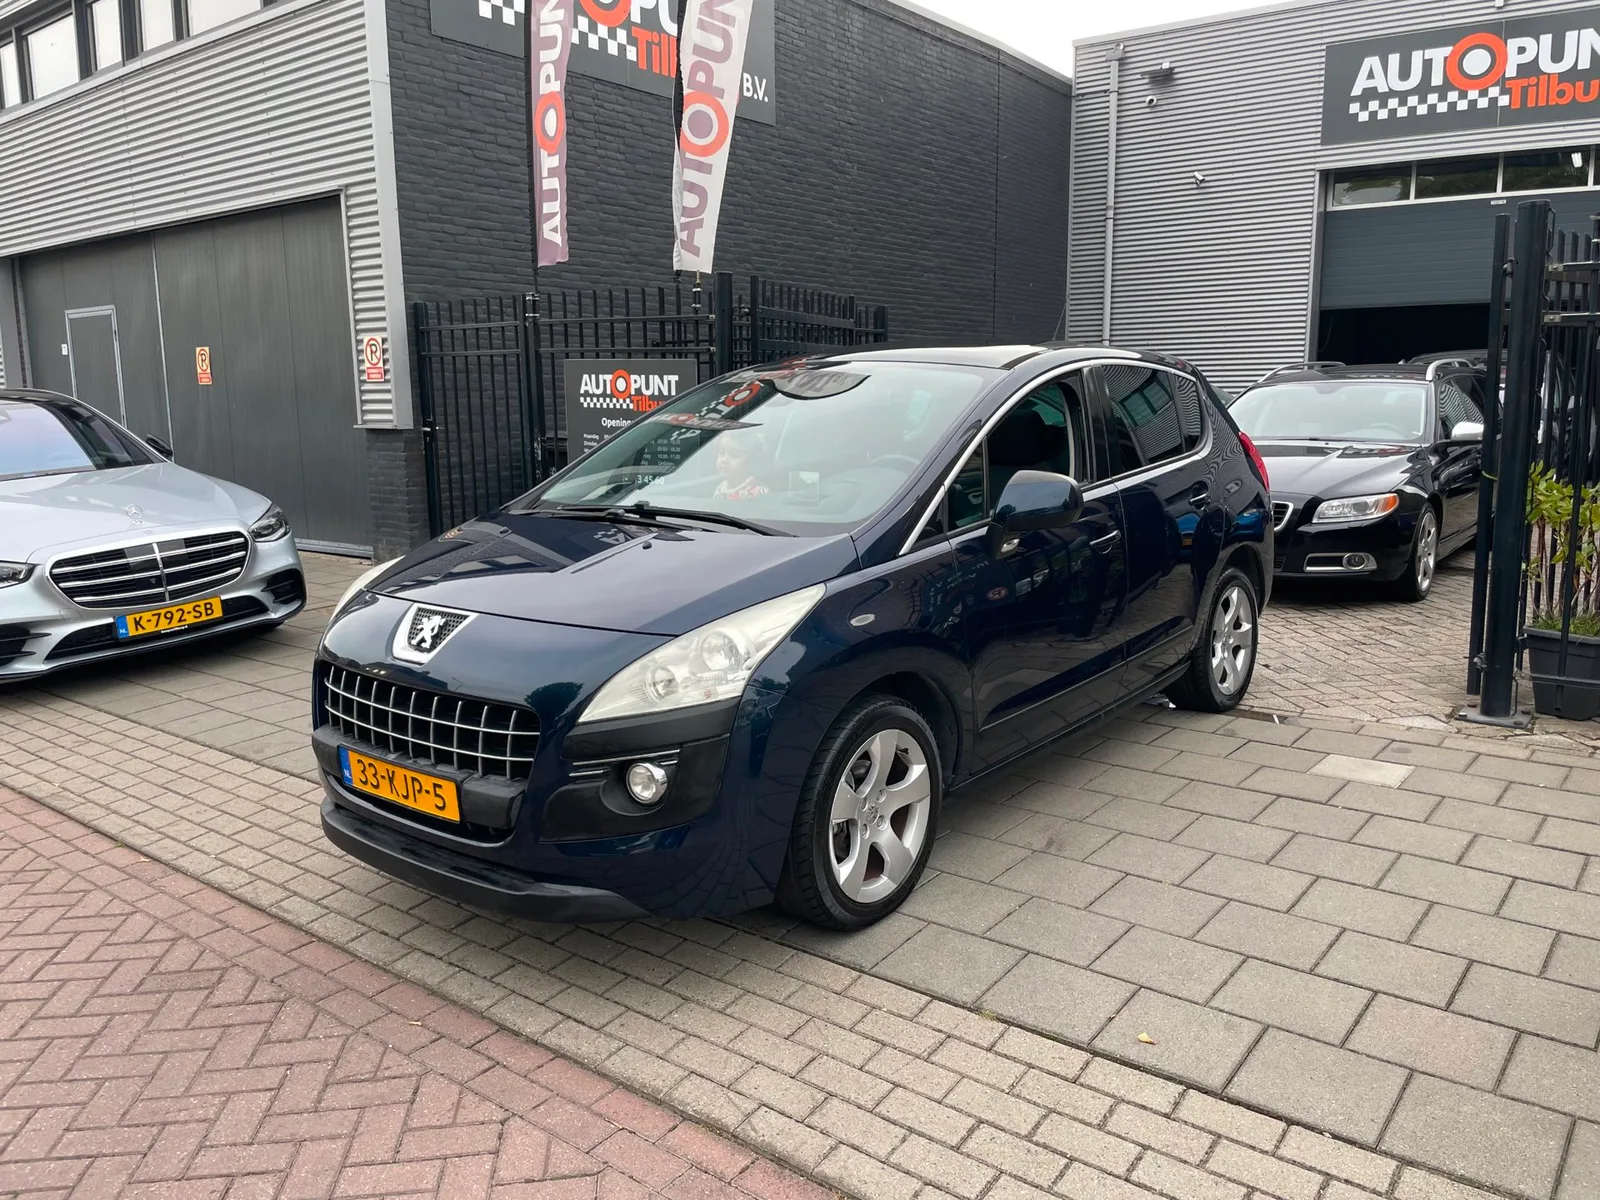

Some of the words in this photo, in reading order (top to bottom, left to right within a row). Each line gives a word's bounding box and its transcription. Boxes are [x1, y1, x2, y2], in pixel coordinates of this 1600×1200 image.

[743, 72, 769, 103] B.V.
[580, 369, 679, 399] AUTOPUNT
[133, 602, 214, 632] K-792-SB
[343, 768, 352, 779] NL
[356, 758, 447, 812] 33-KJP-5
